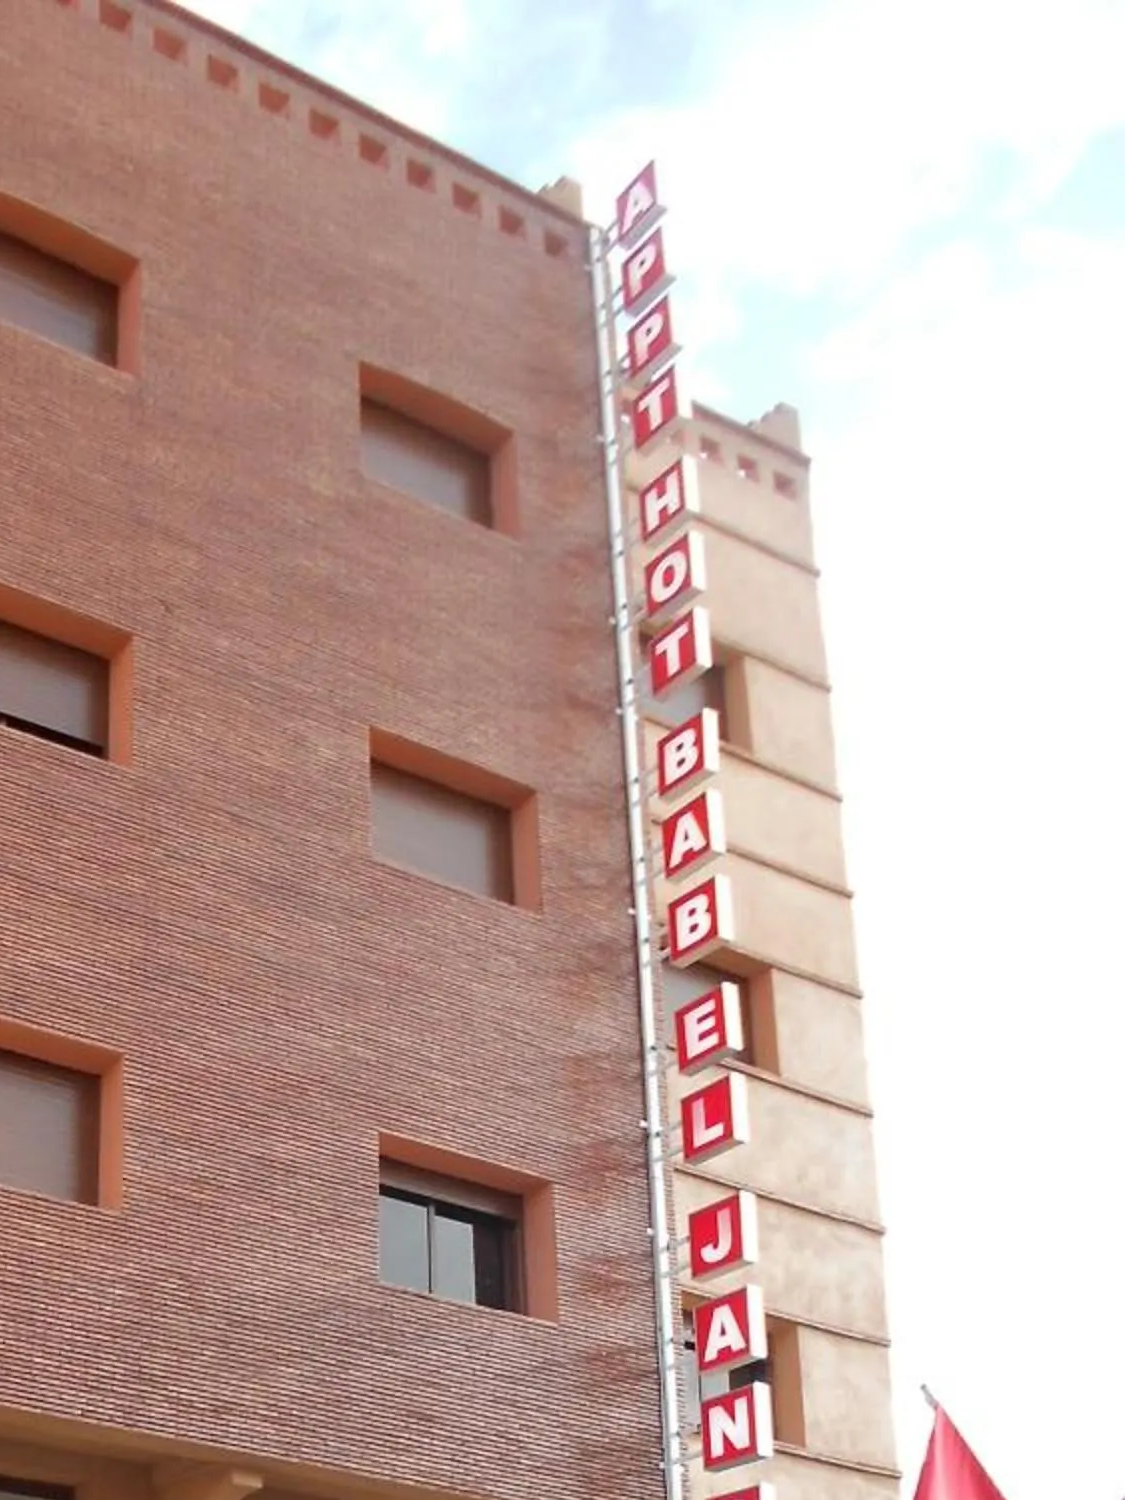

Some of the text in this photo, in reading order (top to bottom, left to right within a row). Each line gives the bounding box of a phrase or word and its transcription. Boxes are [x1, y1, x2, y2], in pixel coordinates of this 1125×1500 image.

[620, 181, 672, 434] APPT
[645, 478, 688, 679] HOT
[663, 729, 712, 952] BAB
[683, 999, 724, 1147] EL
